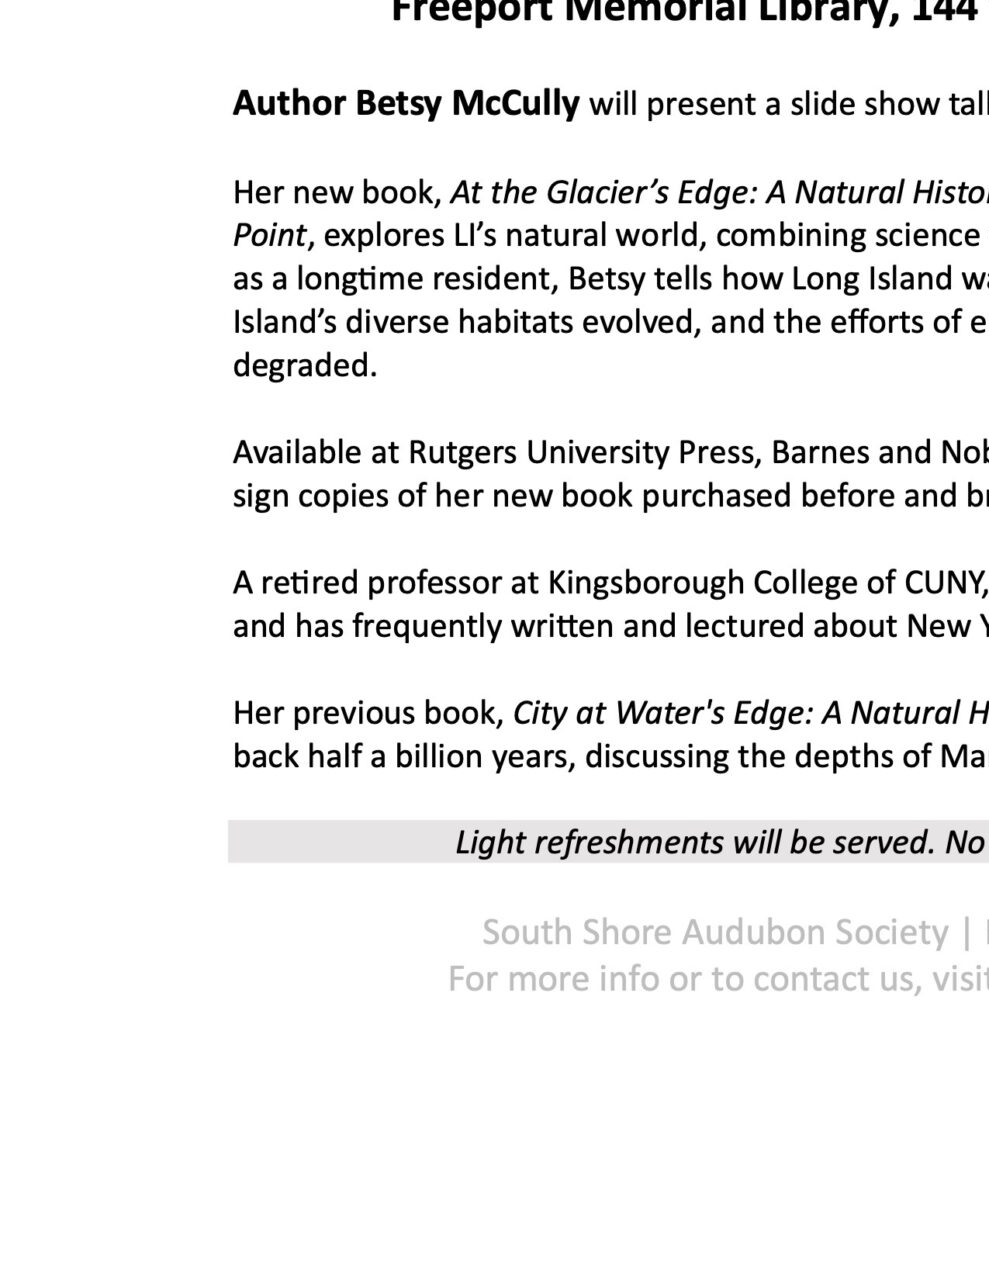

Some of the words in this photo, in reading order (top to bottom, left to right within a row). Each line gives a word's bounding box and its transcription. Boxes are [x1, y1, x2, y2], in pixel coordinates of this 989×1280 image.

[233, 88, 347, 116] Author
[357, 90, 442, 122] Betsy
[453, 88, 580, 122] McCully
[589, 90, 636, 115] will
[648, 93, 756, 121] present
[766, 97, 780, 115] a
[791, 90, 855, 116] slide
[865, 90, 940, 115] show
[235, 180, 285, 204] Her
[294, 186, 354, 204] new
[363, 178, 441, 209] book,
[449, 180, 483, 204] At
[492, 178, 537, 204] the
[547, 178, 669, 204] Glacier’s
[678, 178, 757, 210] Edge:
[765, 180, 785, 204] A
[795, 178, 905, 204] Natural
[233, 570, 253, 594] A
[263, 569, 357, 594] retired
[369, 568, 503, 600] professor
[512, 572, 539, 594] at
[550, 568, 743, 600] Kingsborough
[754, 568, 857, 600] College
[868, 568, 897, 594] of
[906, 570, 988, 599] CUNY,
[234, 612, 284, 638] and
[297, 612, 343, 638] has
[352, 612, 502, 643] frequently
[511, 613, 612, 638] written
[624, 612, 675, 638] and
[687, 612, 803, 638] lectured
[814, 612, 897, 638] about
[908, 613, 971, 637] New
[456, 828, 527, 860] Light
[535, 828, 724, 860] refreshments
[734, 828, 782, 854] will
[790, 828, 825, 854] be
[833, 828, 933, 854] served.
[946, 830, 985, 854] No
[484, 918, 570, 944] South
[584, 918, 670, 944] Shore
[683, 918, 823, 944] Audubon
[837, 919, 948, 950] Society
[451, 966, 497, 990] For
[511, 972, 588, 990] more
[602, 965, 658, 990] info
[671, 973, 701, 990] or
[712, 968, 743, 990] to
[755, 968, 868, 990] contact
[882, 972, 920, 995] us,
